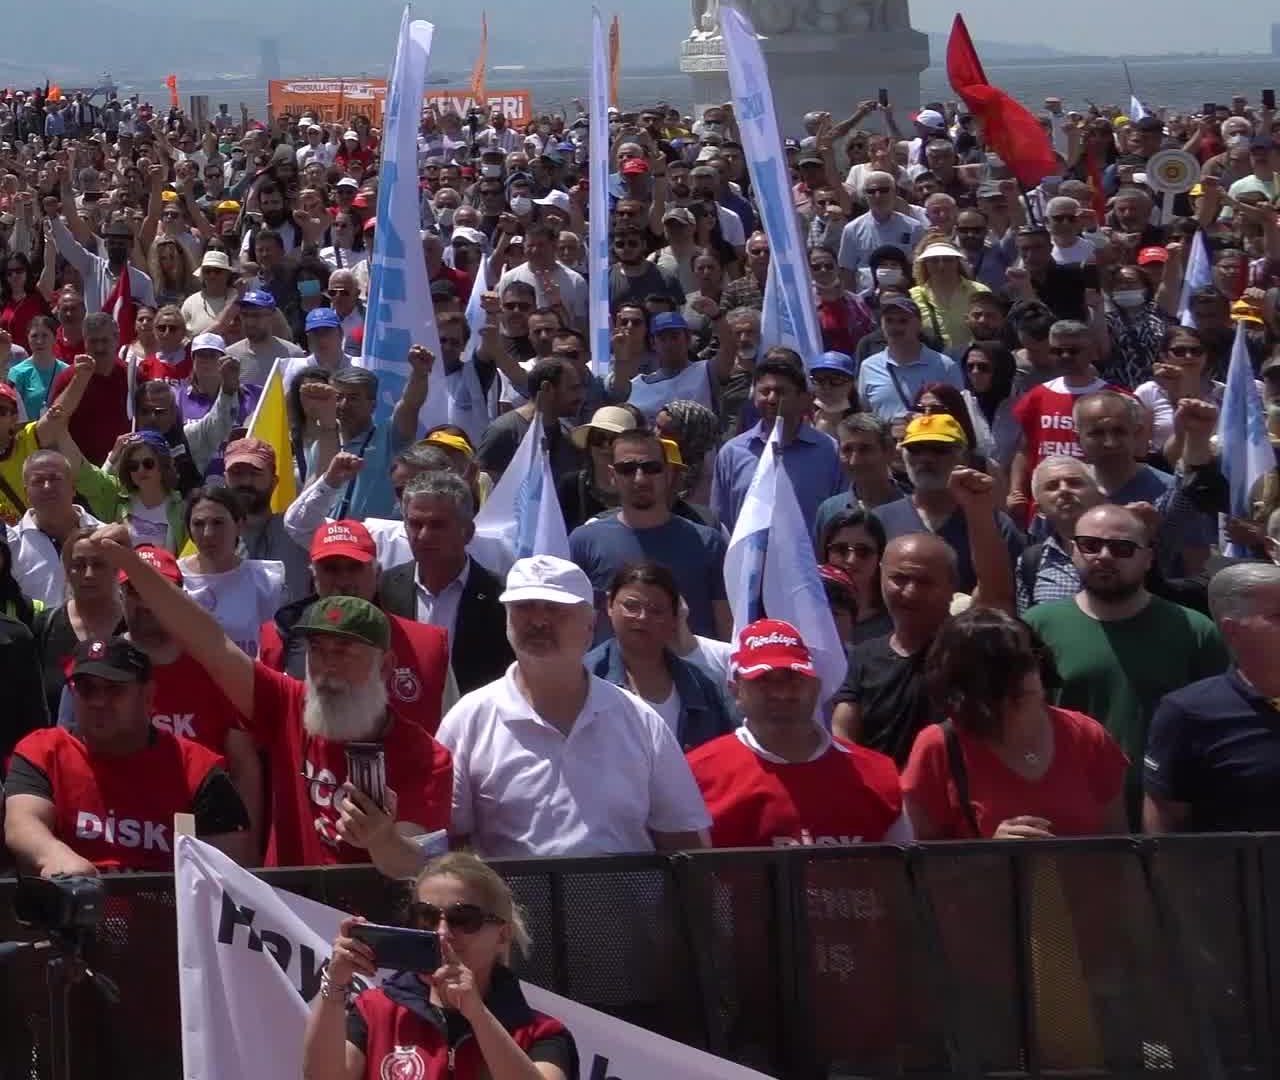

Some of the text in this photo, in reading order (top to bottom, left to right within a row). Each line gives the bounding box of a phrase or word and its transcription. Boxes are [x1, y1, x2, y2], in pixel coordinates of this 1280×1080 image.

[1040, 410, 1073, 430] DİS
[328, 524, 351, 535] DİSK
[138, 550, 154, 560] İSK
[152, 713, 197, 737] SK
[76, 809, 171, 853] DİSK
